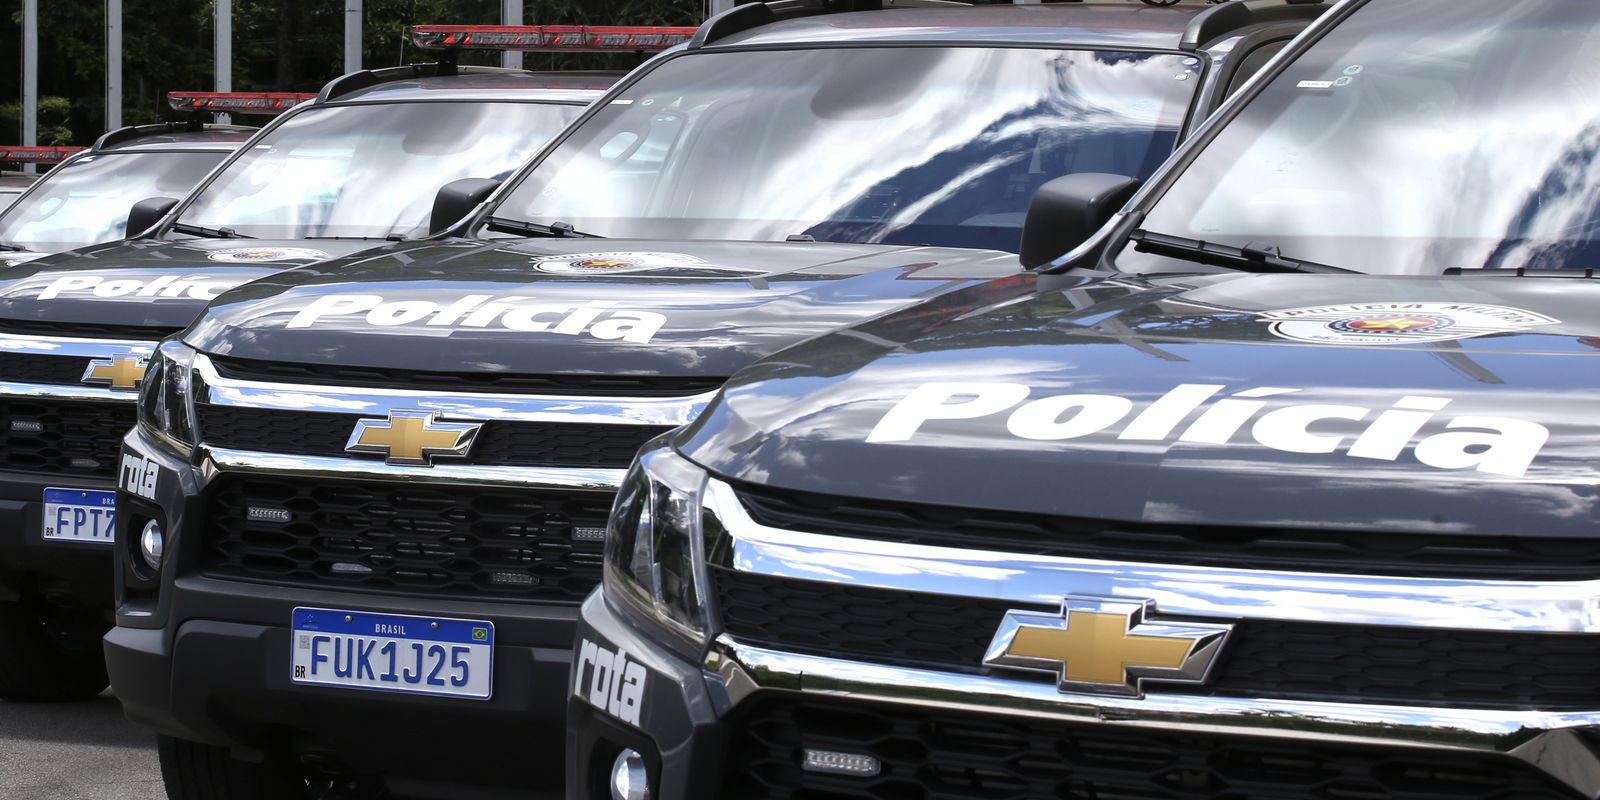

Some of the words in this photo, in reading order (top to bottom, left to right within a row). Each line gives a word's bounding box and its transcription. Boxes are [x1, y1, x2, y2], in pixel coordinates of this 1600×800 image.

[36, 275, 253, 301] Políc
[285, 294, 667, 344] Polícia
[865, 382, 1550, 478] Polícia
[119, 453, 160, 500] rota
[375, 623, 407, 635] BRASIL
[295, 665, 306, 679] BR
[311, 635, 470, 687] FUK1J25
[575, 638, 647, 727] rota
